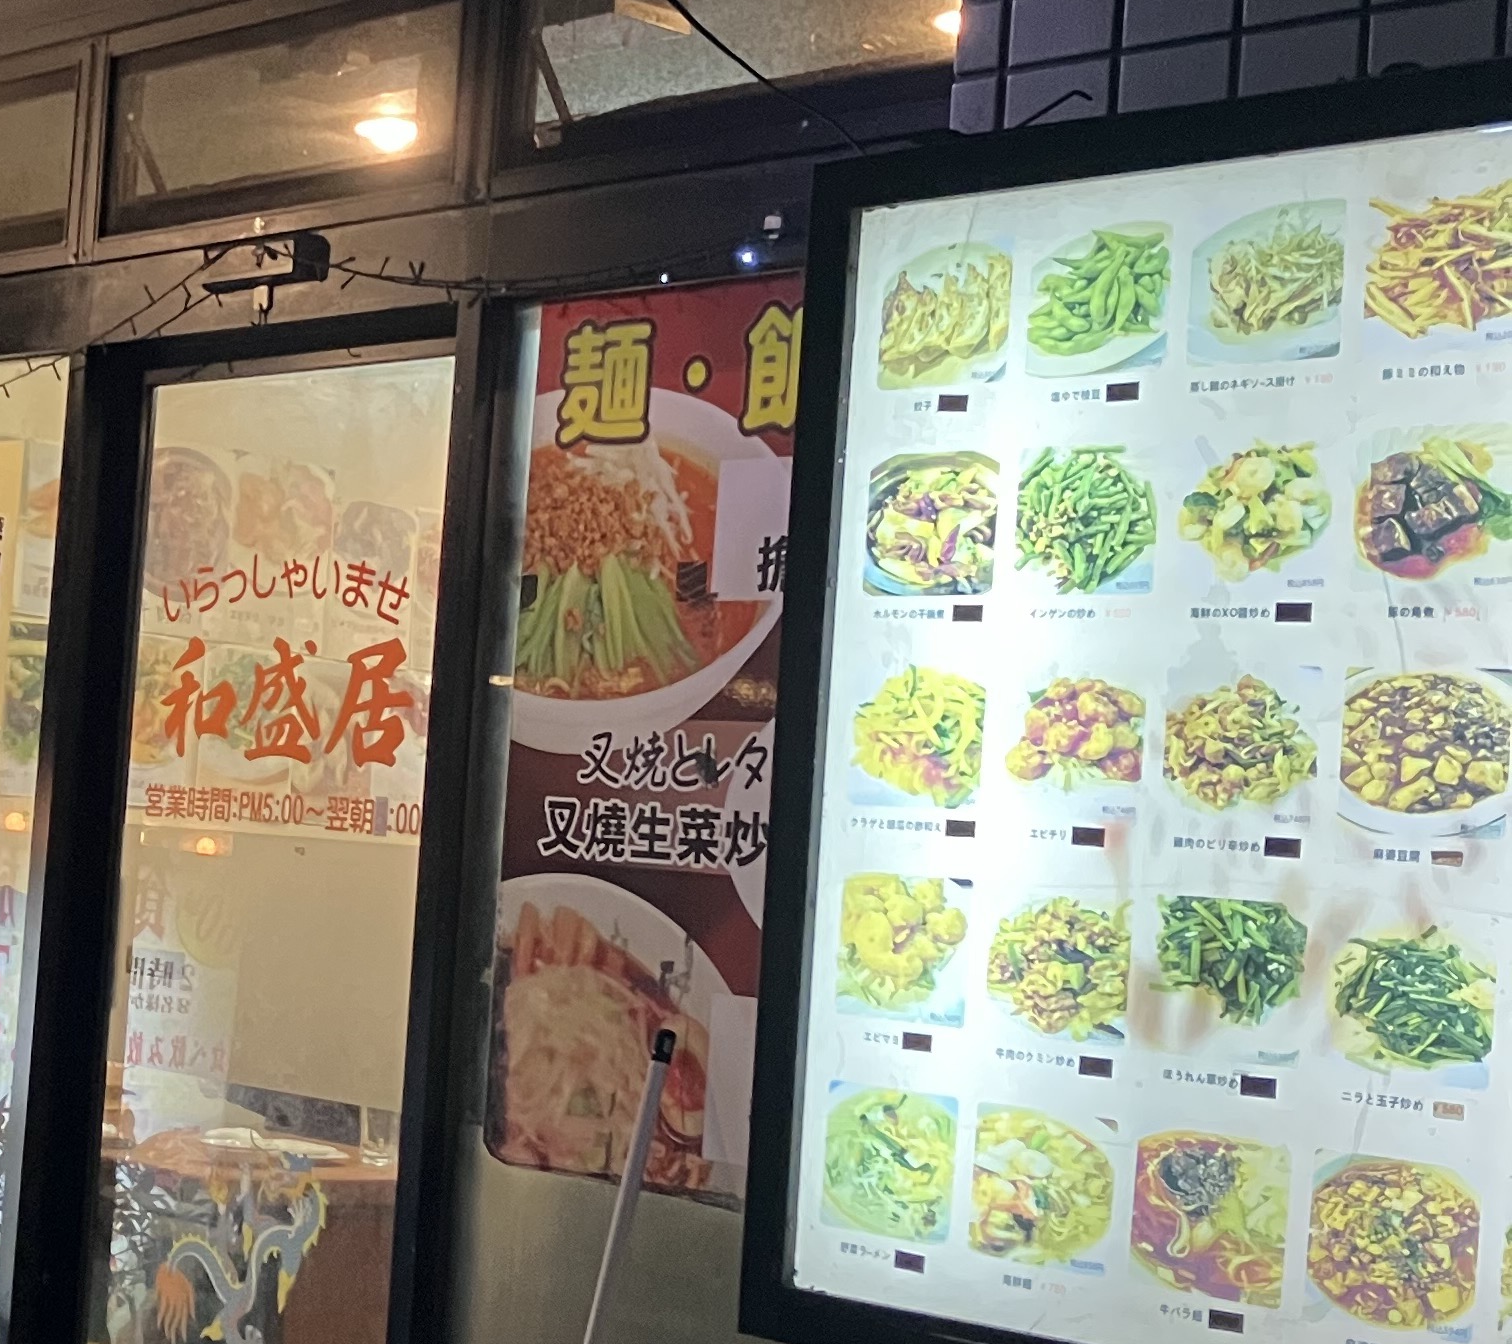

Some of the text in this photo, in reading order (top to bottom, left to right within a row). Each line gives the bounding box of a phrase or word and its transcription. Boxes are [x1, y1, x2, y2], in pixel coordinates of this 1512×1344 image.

[161, 553, 411, 626] いらっしゃいませ
[159, 635, 415, 768] 和盛居
